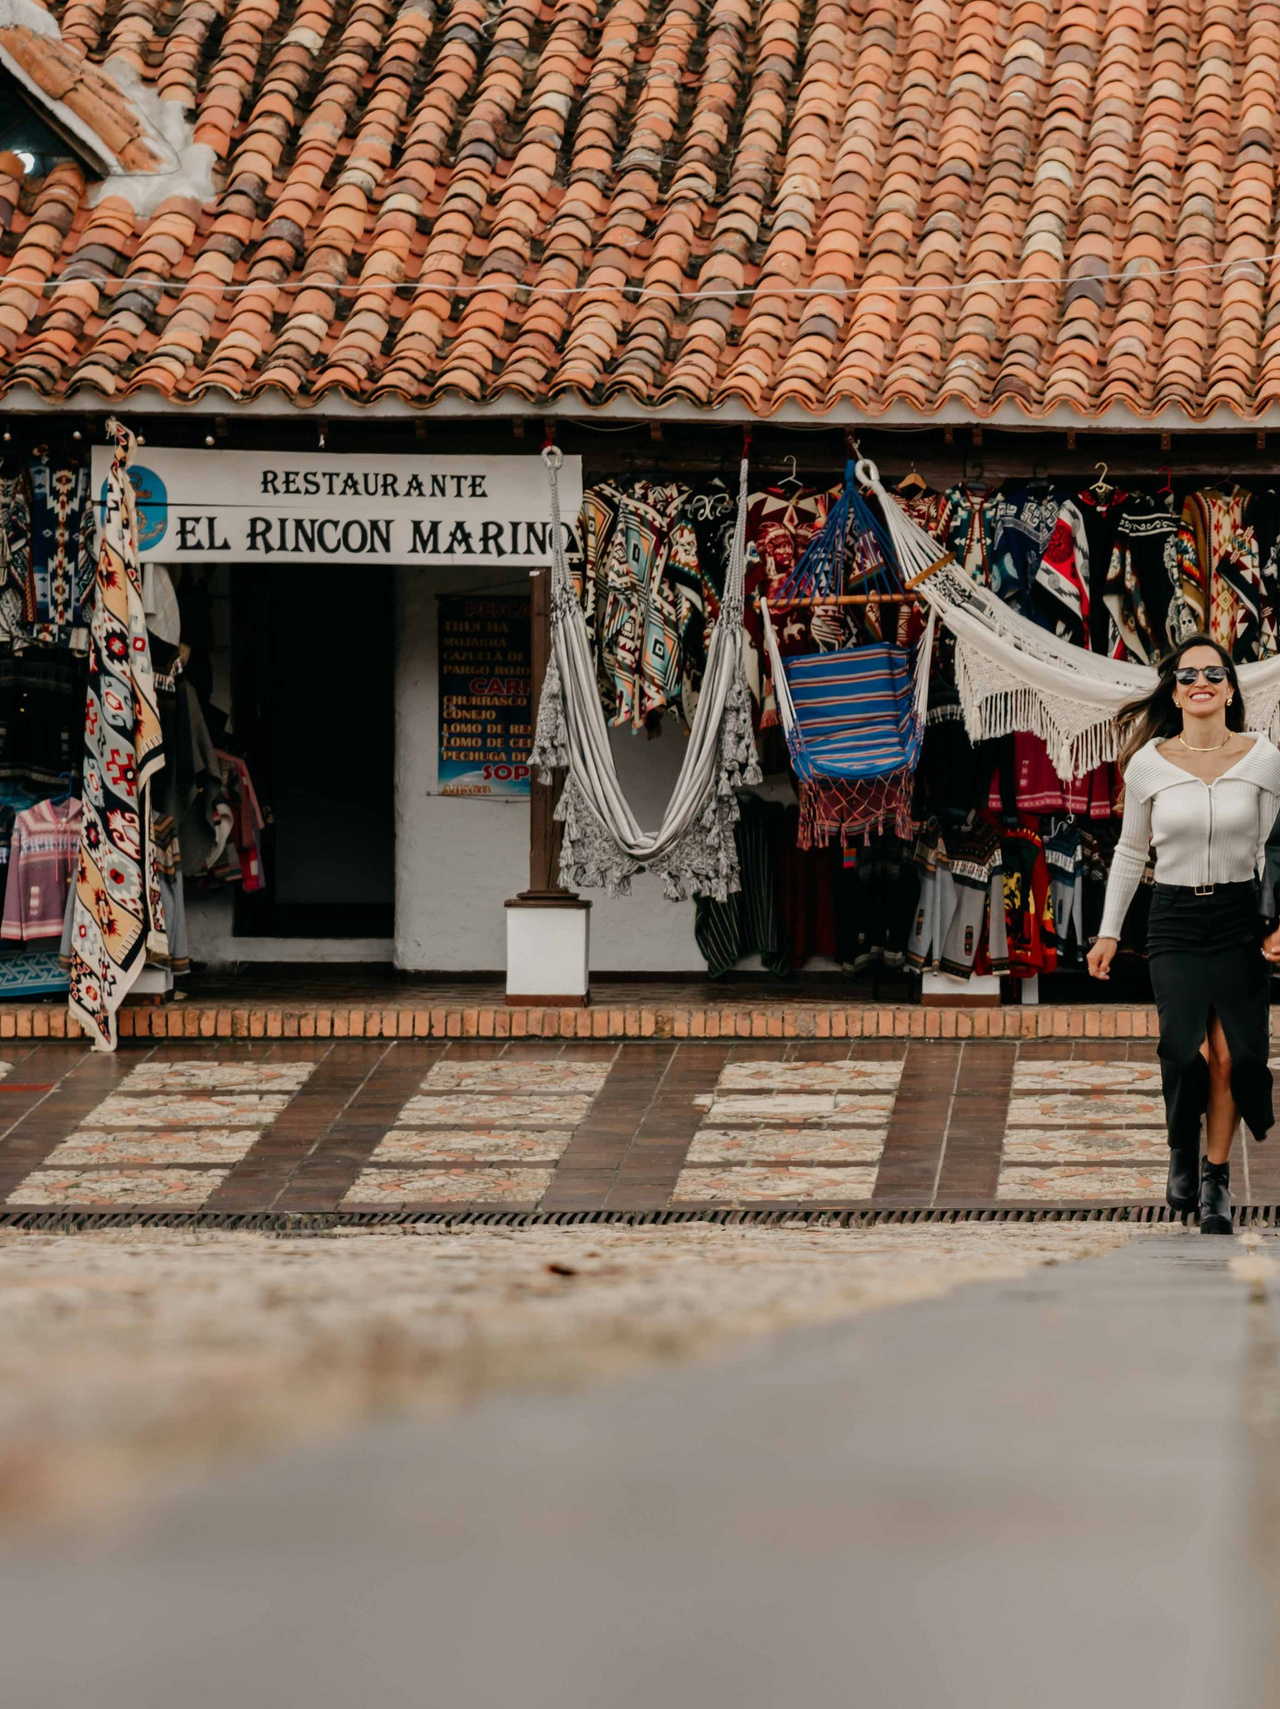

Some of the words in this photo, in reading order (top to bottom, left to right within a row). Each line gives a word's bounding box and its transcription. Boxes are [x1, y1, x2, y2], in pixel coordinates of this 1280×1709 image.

[261, 470, 489, 498] RESTAURANTE
[176, 516, 231, 551] EL
[246, 517, 396, 554] RINCON
[445, 620, 509, 632] TRUCHA
[443, 650, 504, 662] CAZUELA
[507, 650, 526, 662] DE
[443, 664, 490, 676] PARGO
[493, 665, 531, 676] ROJO
[442, 695, 528, 706] CHURRASCO
[442, 709, 497, 720] CONEJO
[486, 724, 505, 734] DE
[442, 736, 483, 747] LOMO
[486, 737, 505, 748] DE
[442, 750, 508, 761] PECHUGA
